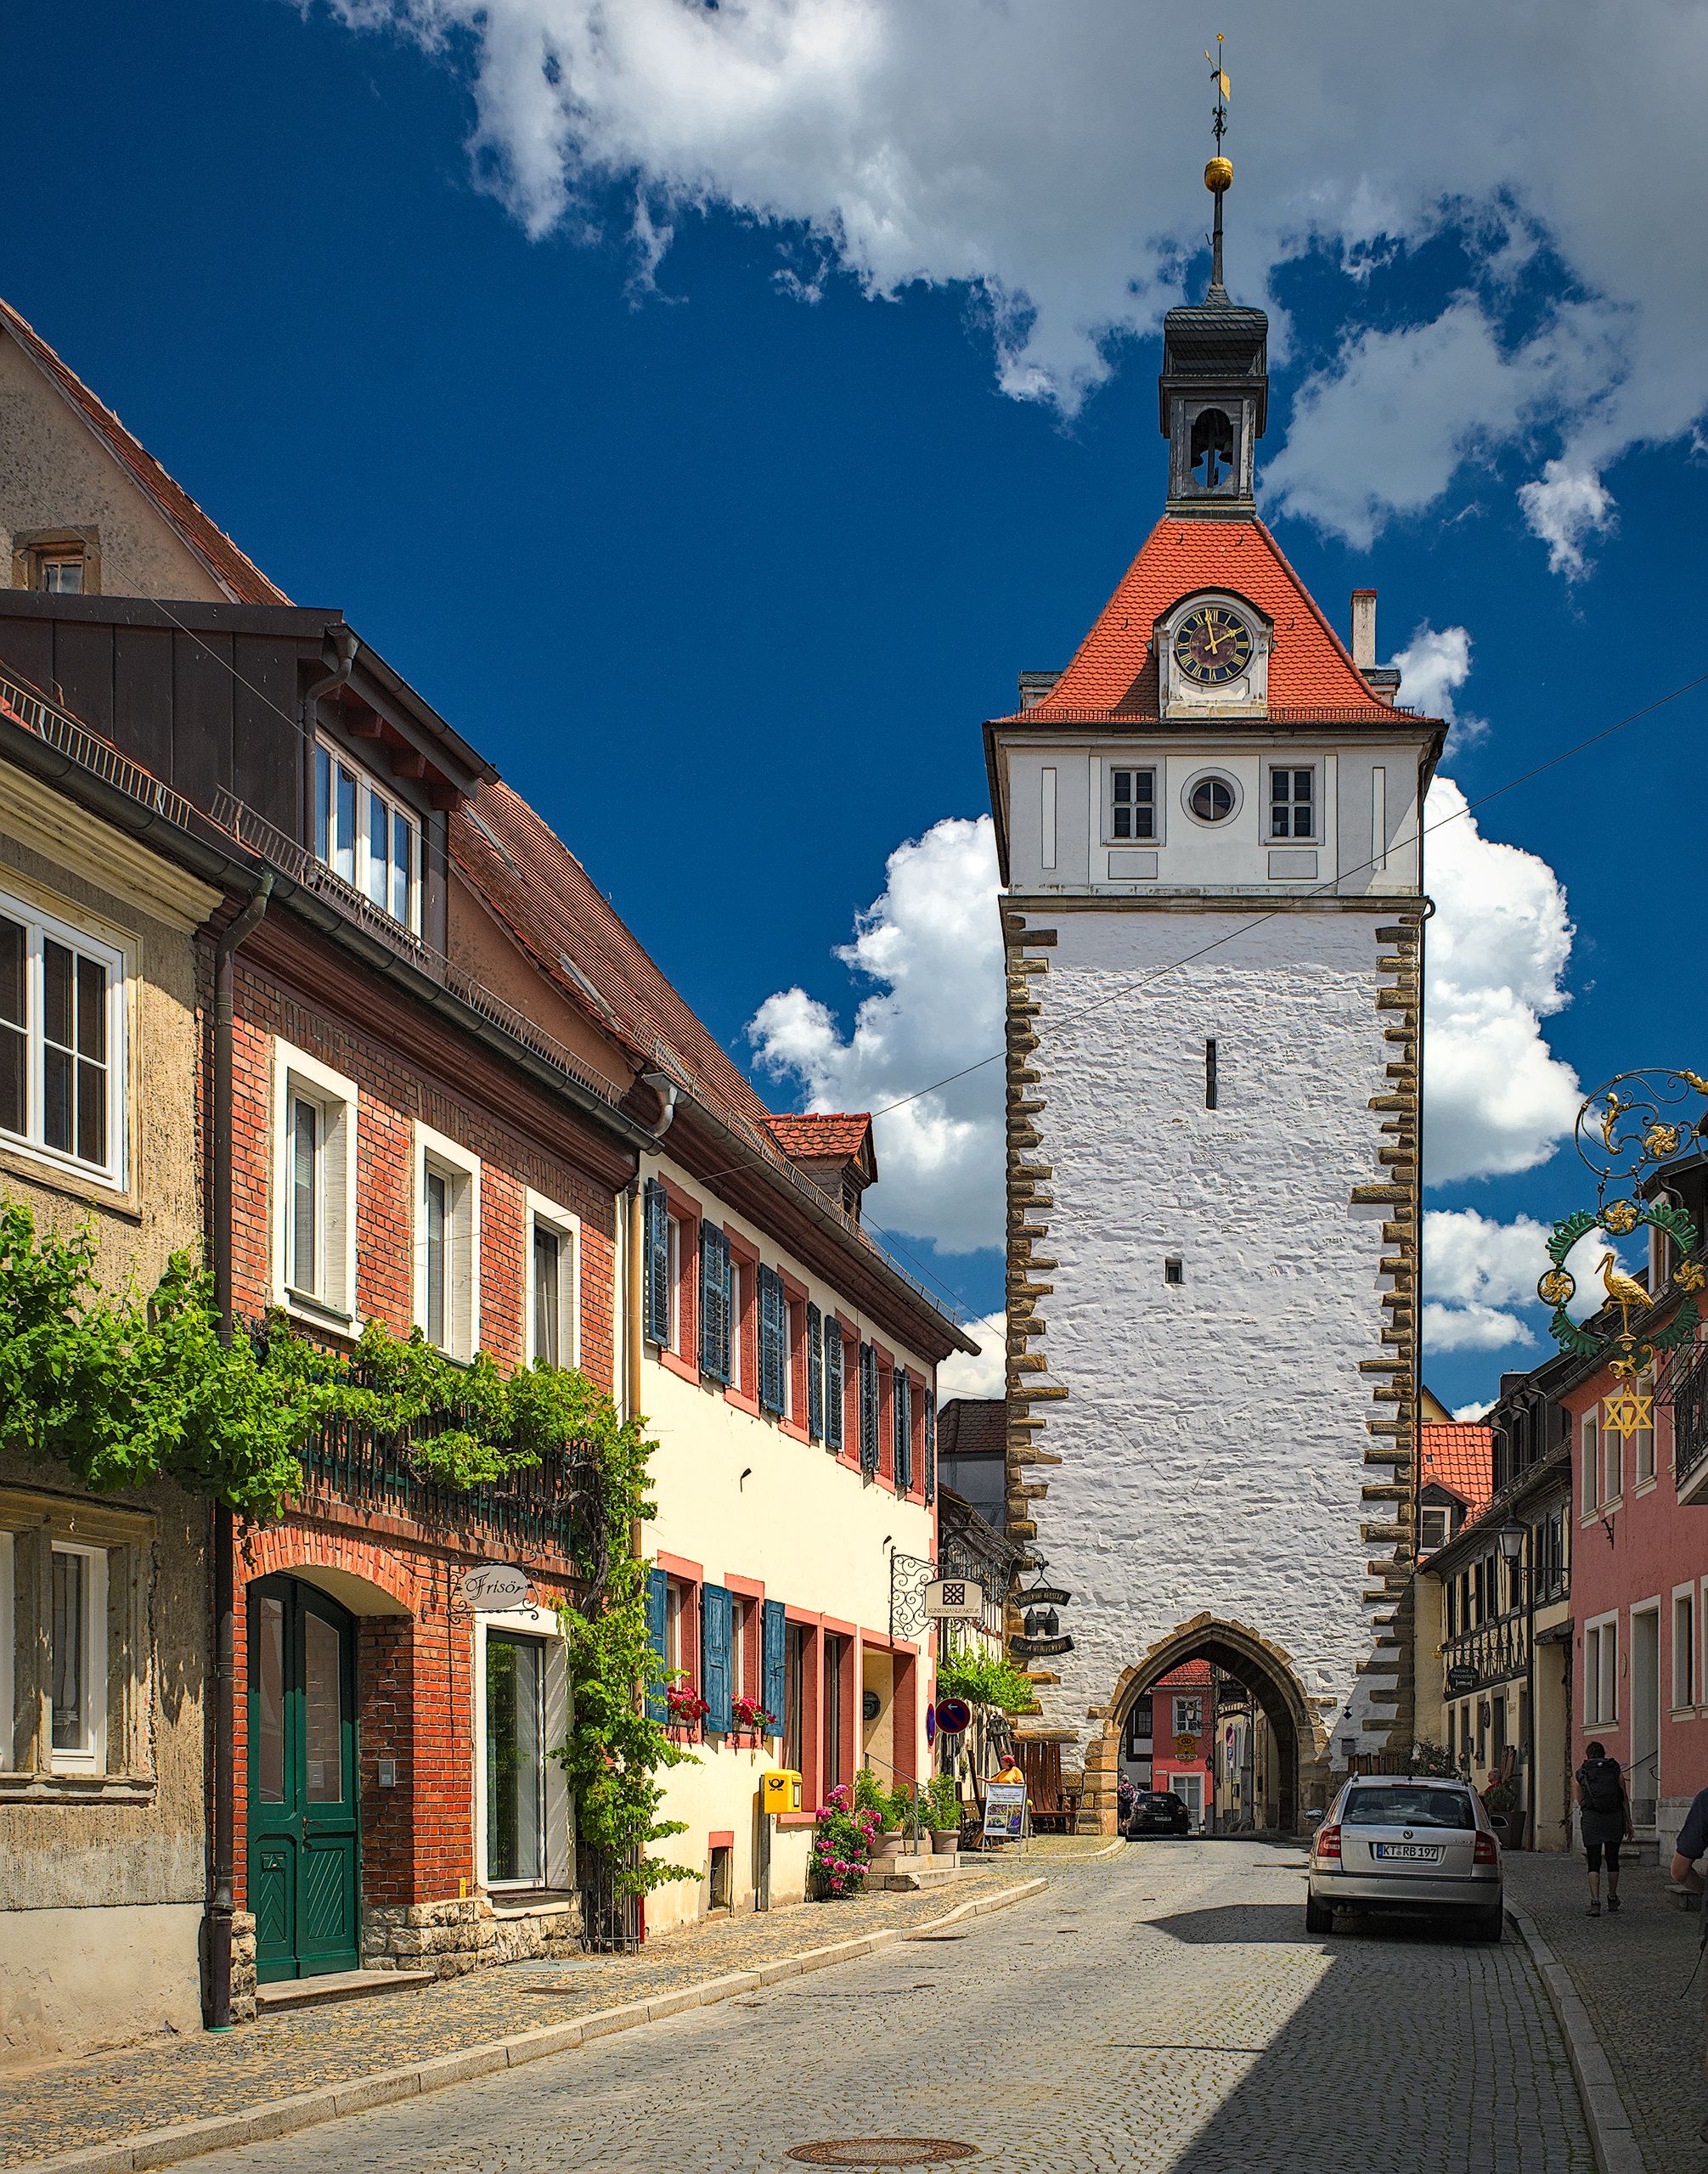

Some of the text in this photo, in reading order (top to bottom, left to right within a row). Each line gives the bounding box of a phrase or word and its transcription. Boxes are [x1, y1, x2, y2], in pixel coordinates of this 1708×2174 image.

[465, 1572, 523, 1601] Frisör
[1384, 1845, 1437, 1857] KT RB 197
